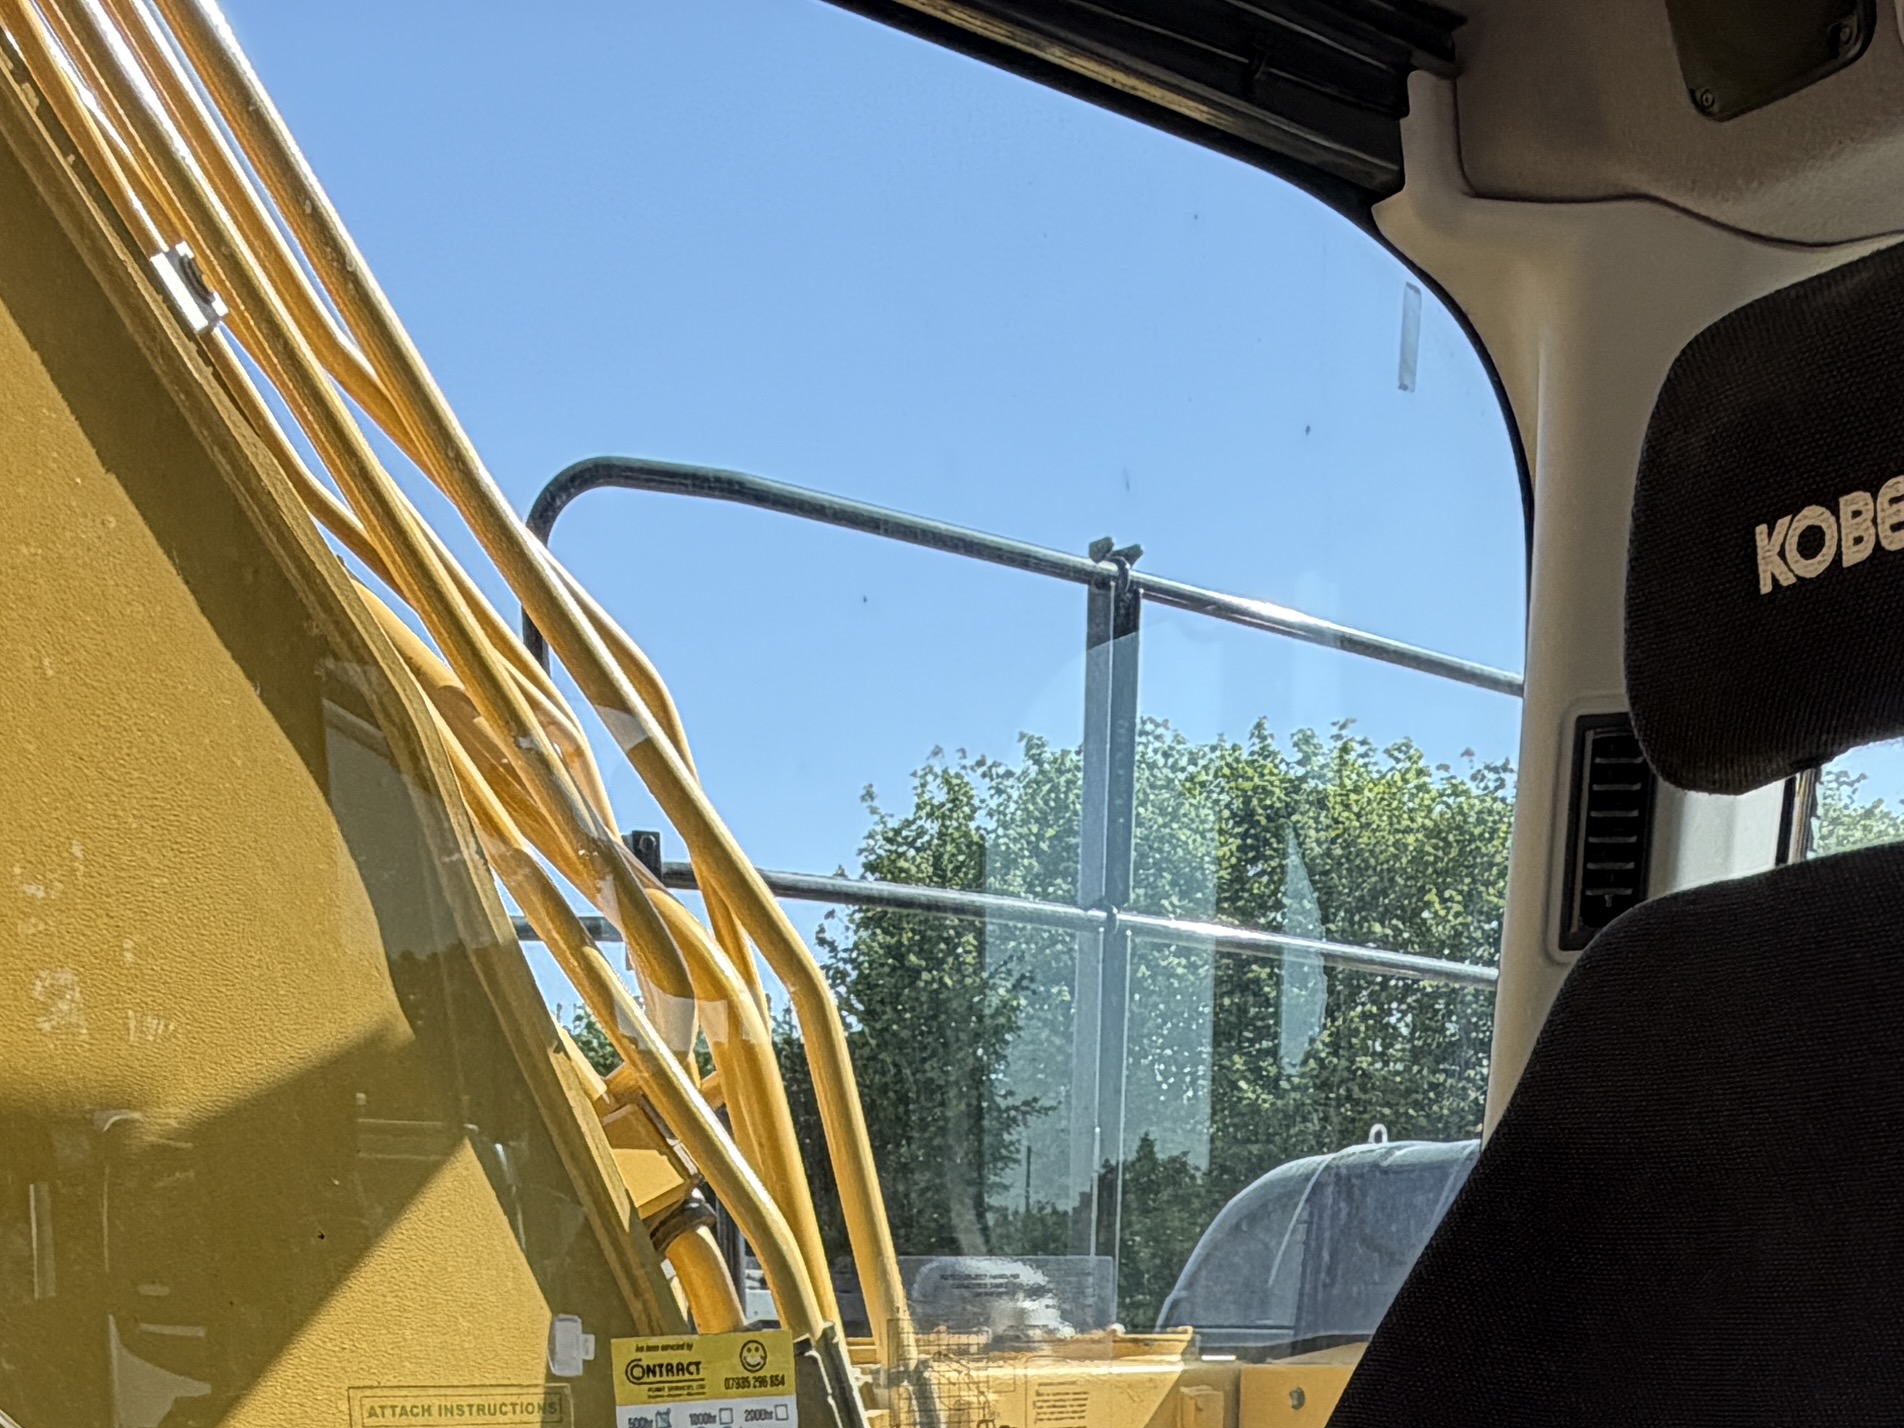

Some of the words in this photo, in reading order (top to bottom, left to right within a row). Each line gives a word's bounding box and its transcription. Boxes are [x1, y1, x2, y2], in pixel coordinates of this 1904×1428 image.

[625, 1358, 701, 1385] CONTRACT
[367, 1405, 432, 1419] ATTACH
[438, 1402, 557, 1417] INSTRUCTIONS
[745, 1409, 773, 1421] 2000hr
[689, 1413, 717, 1425] 1000hr
